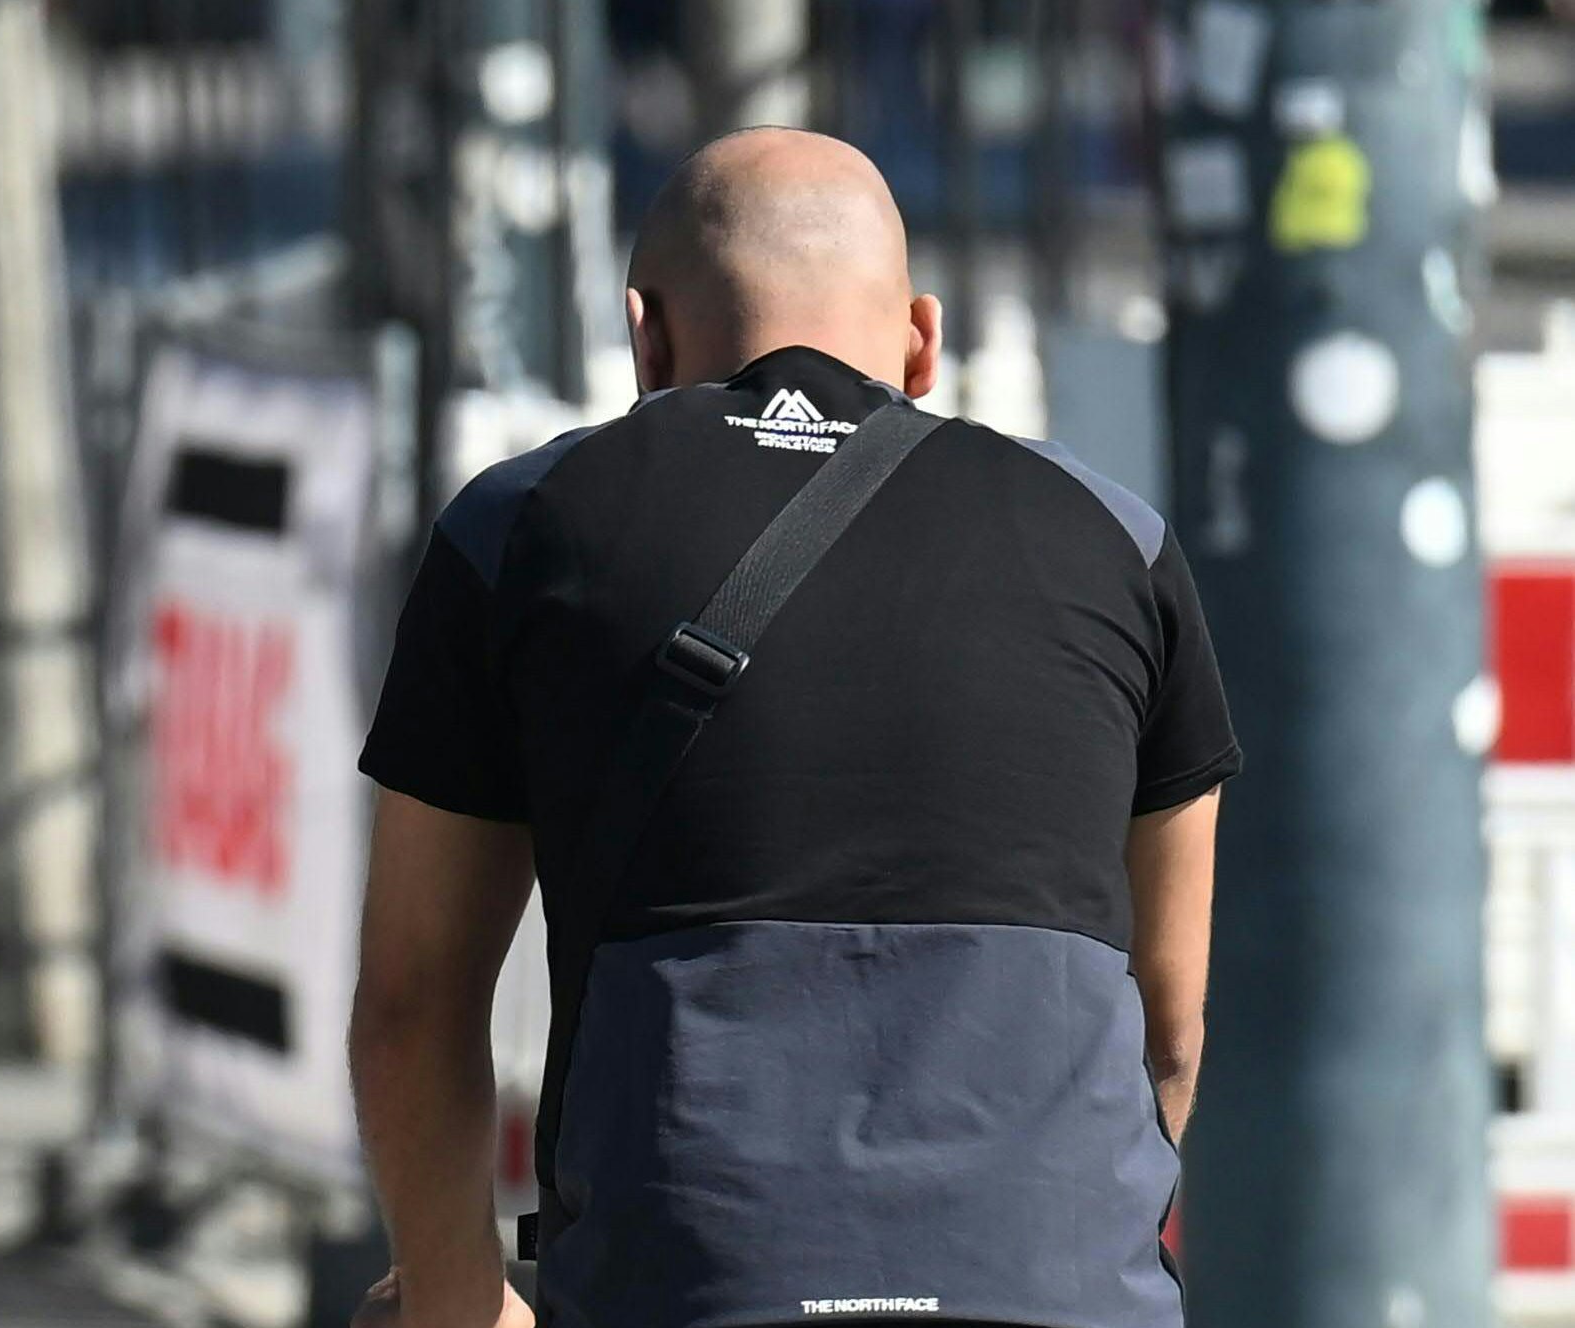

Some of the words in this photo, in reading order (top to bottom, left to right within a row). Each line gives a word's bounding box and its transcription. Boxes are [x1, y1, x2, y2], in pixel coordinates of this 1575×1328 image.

[724, 415, 758, 429] THE
[758, 419, 819, 434] NORTH
[801, 1300, 834, 1314] THE
[834, 1299, 895, 1313] NORTH
[895, 1298, 939, 1312] FACE
